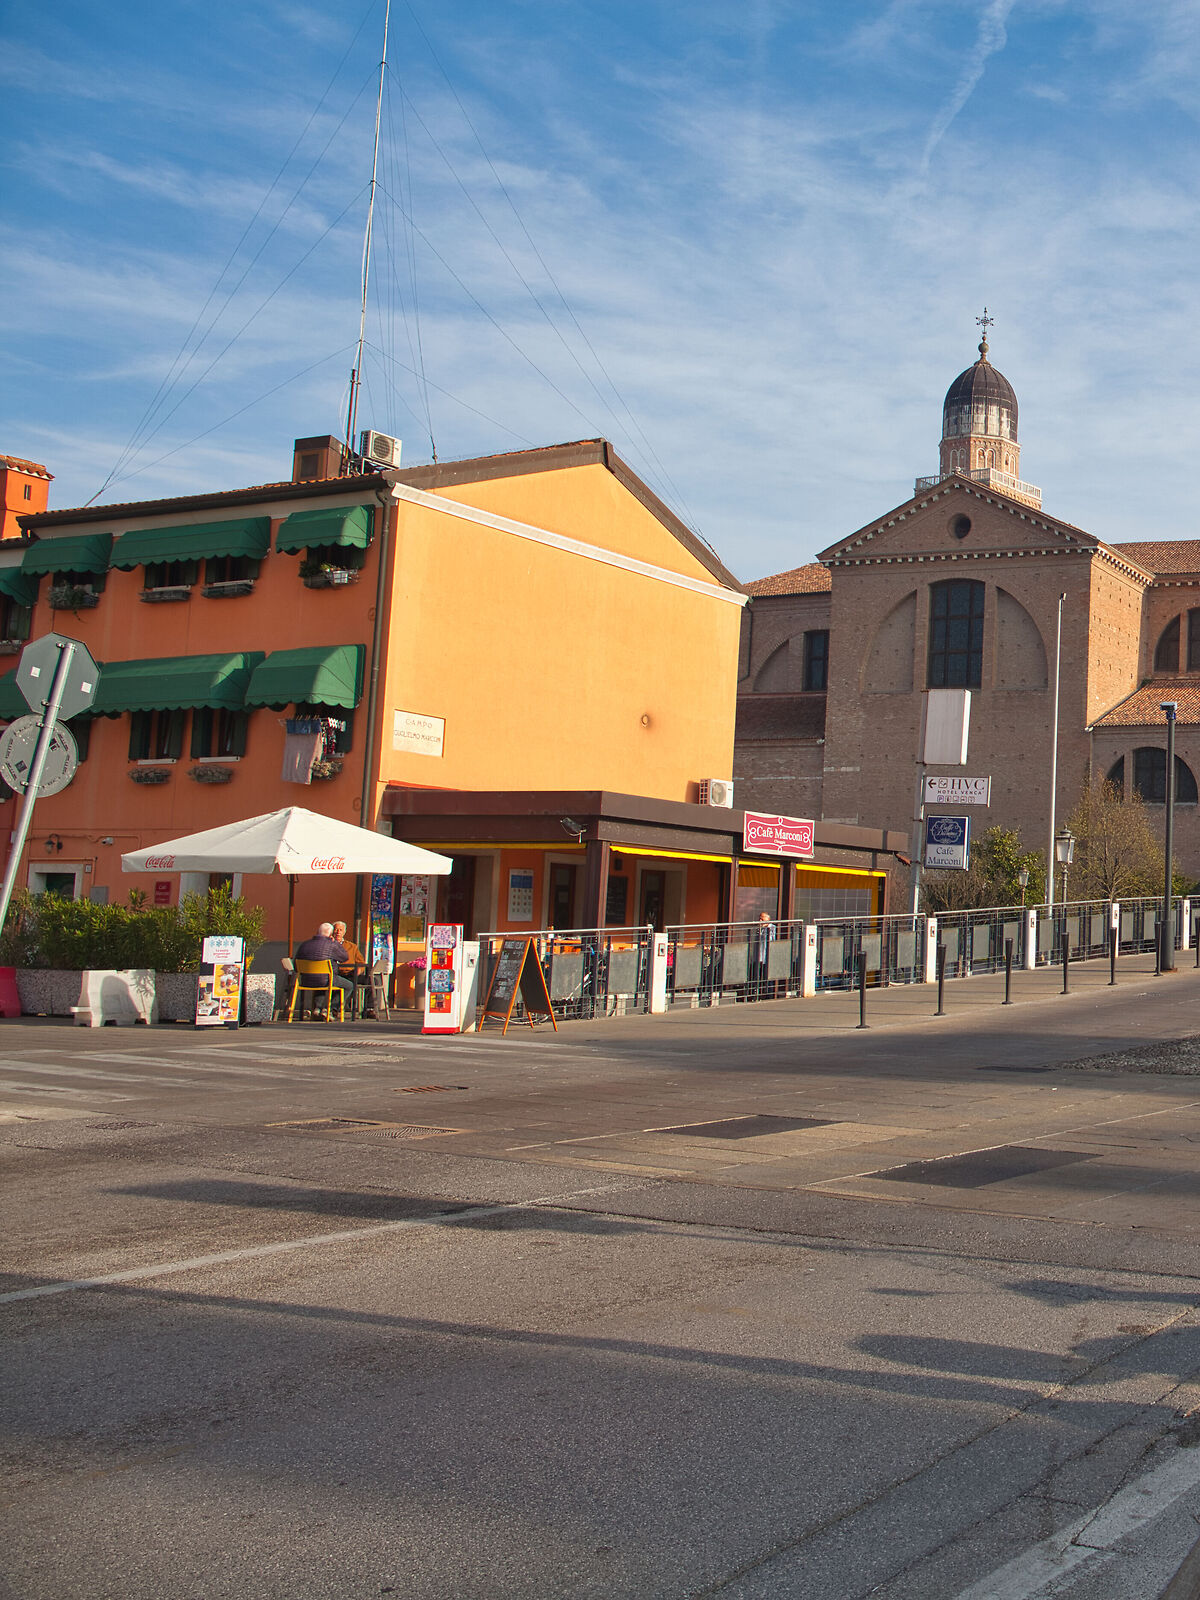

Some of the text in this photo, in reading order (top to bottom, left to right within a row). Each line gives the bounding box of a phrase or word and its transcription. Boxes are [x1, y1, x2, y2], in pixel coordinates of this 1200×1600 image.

[405, 719, 433, 728] CAMPO
[951, 779, 985, 790] HVC
[774, 828, 803, 842] Marconi
[927, 856, 961, 865] Marconi
